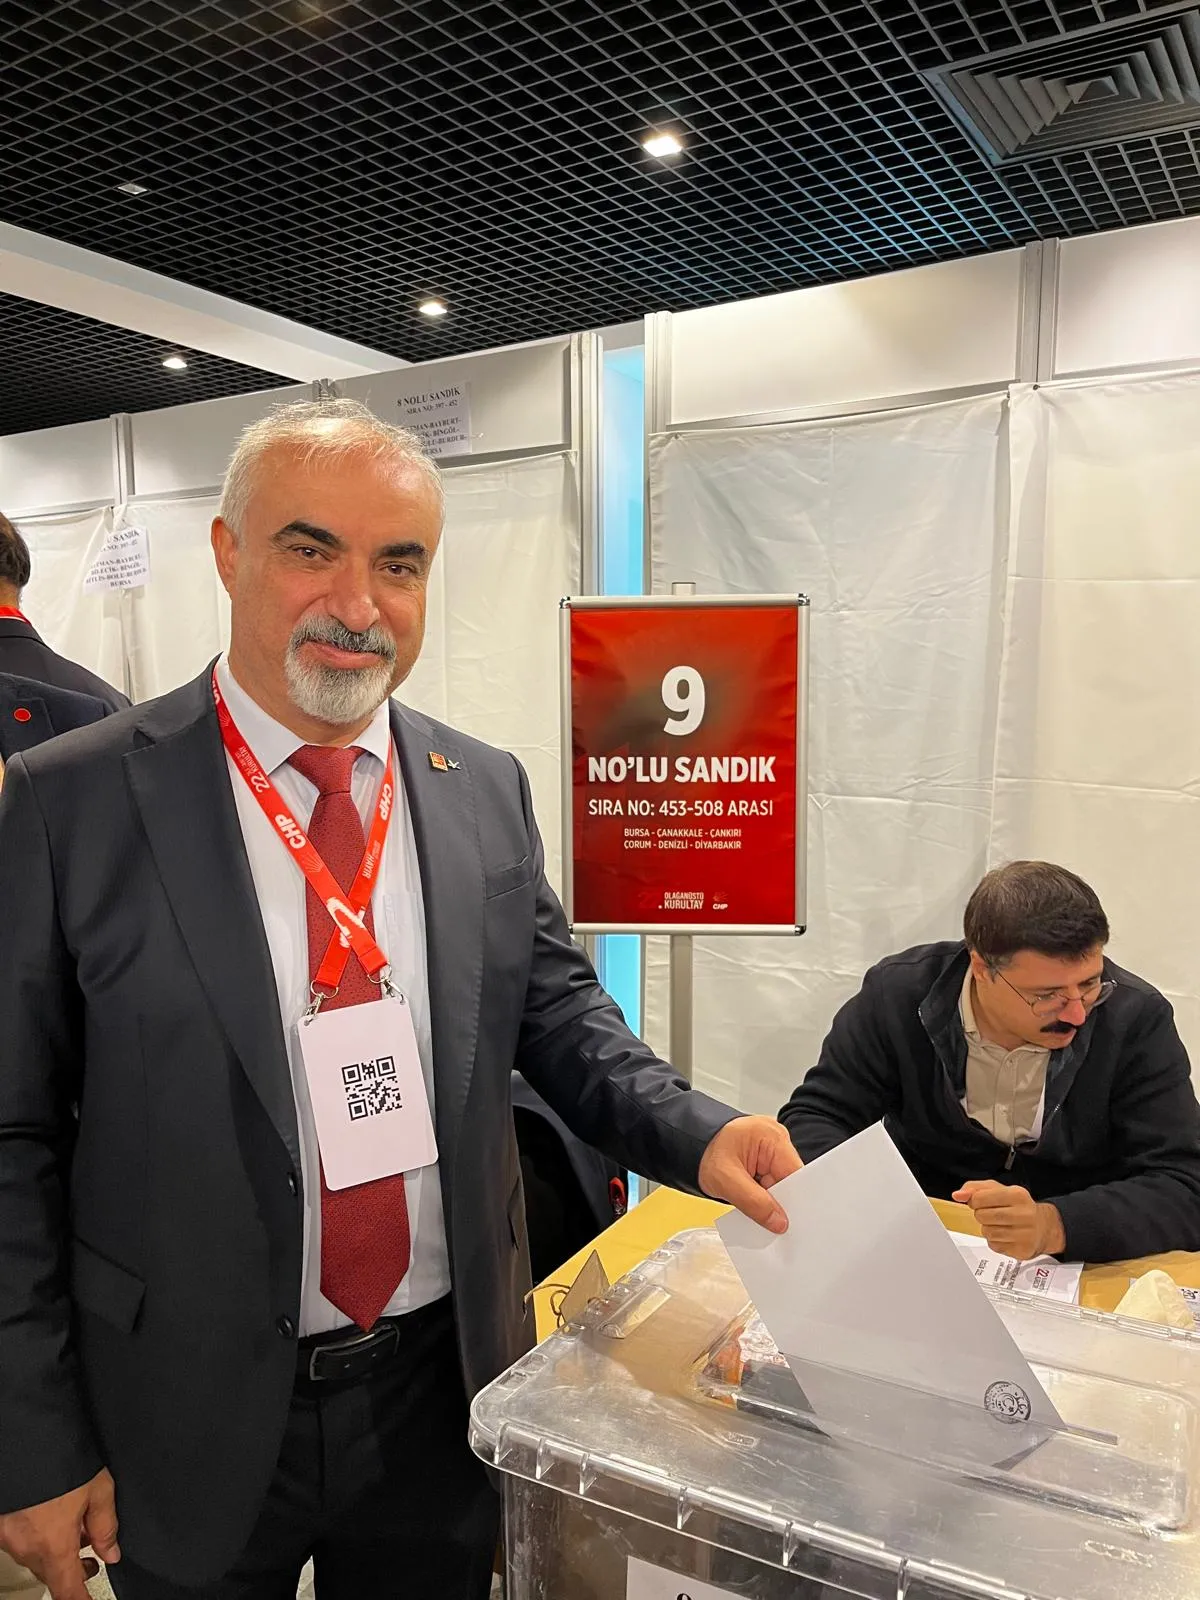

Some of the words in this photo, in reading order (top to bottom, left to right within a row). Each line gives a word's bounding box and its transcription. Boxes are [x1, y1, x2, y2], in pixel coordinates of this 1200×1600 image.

[404, 394, 428, 405] NOLU
[429, 387, 460, 401] SANDIK
[661, 665, 706, 736] 9
[674, 756, 776, 783] SANDIK
[249, 771, 270, 793] 22
[379, 783, 392, 821] CHP
[588, 799, 624, 816] SIRA
[627, 799, 655, 816] NO:
[658, 799, 724, 817] 453-508
[727, 799, 774, 816] ARASI
[274, 813, 307, 850] CHP
[624, 828, 650, 837] BURSA
[656, 828, 703, 838] ÇANAKKALE
[709, 828, 742, 838] ÇANKIRI
[624, 840, 652, 850] ÇORUM
[658, 839, 688, 849] DENİZLİ
[694, 839, 742, 849] DİYARBAKIR
[362, 852, 375, 880] HAYIR
[664, 899, 704, 909] KURULTAY
